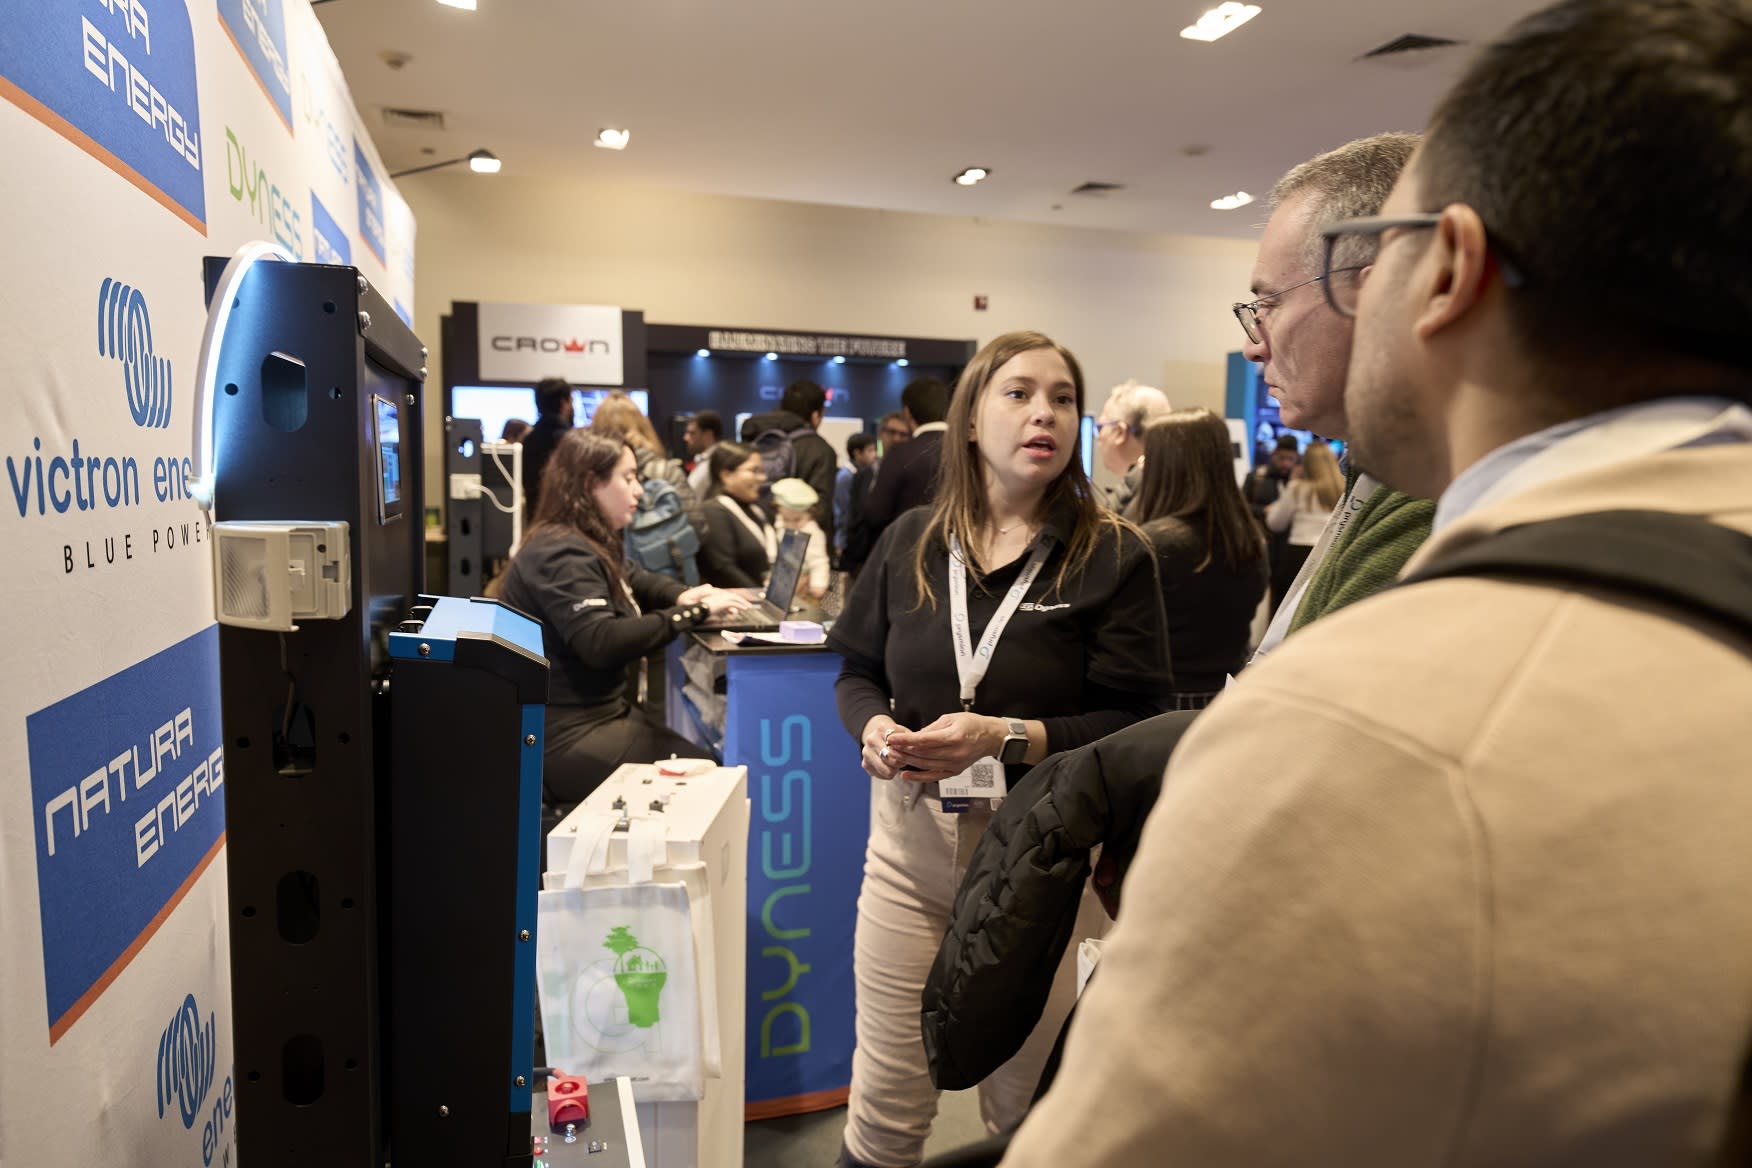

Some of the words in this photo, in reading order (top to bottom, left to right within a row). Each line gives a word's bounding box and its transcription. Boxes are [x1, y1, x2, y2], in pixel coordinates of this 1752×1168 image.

[81, 15, 200, 171] ENERGY
[6, 436, 140, 518] victron
[63, 533, 133, 574] BLUE
[45, 706, 194, 857] NATURA
[134, 743, 225, 869] ENERG
